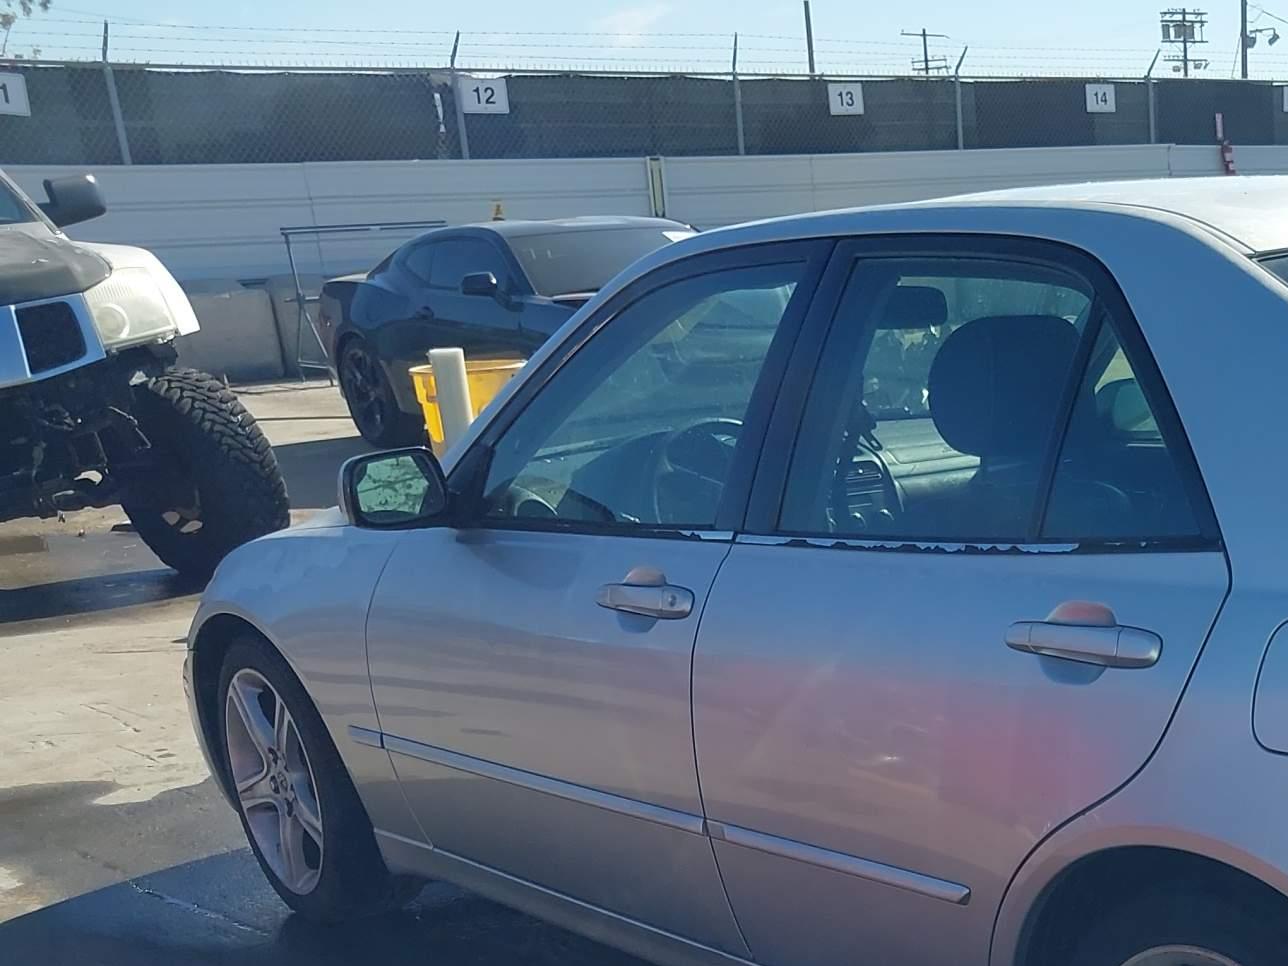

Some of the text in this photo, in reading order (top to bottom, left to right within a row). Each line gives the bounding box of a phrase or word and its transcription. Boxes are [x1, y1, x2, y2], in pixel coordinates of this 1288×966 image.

[472, 86, 496, 105] 12
[837, 91, 855, 107] 13
[1094, 91, 1107, 105] 14
